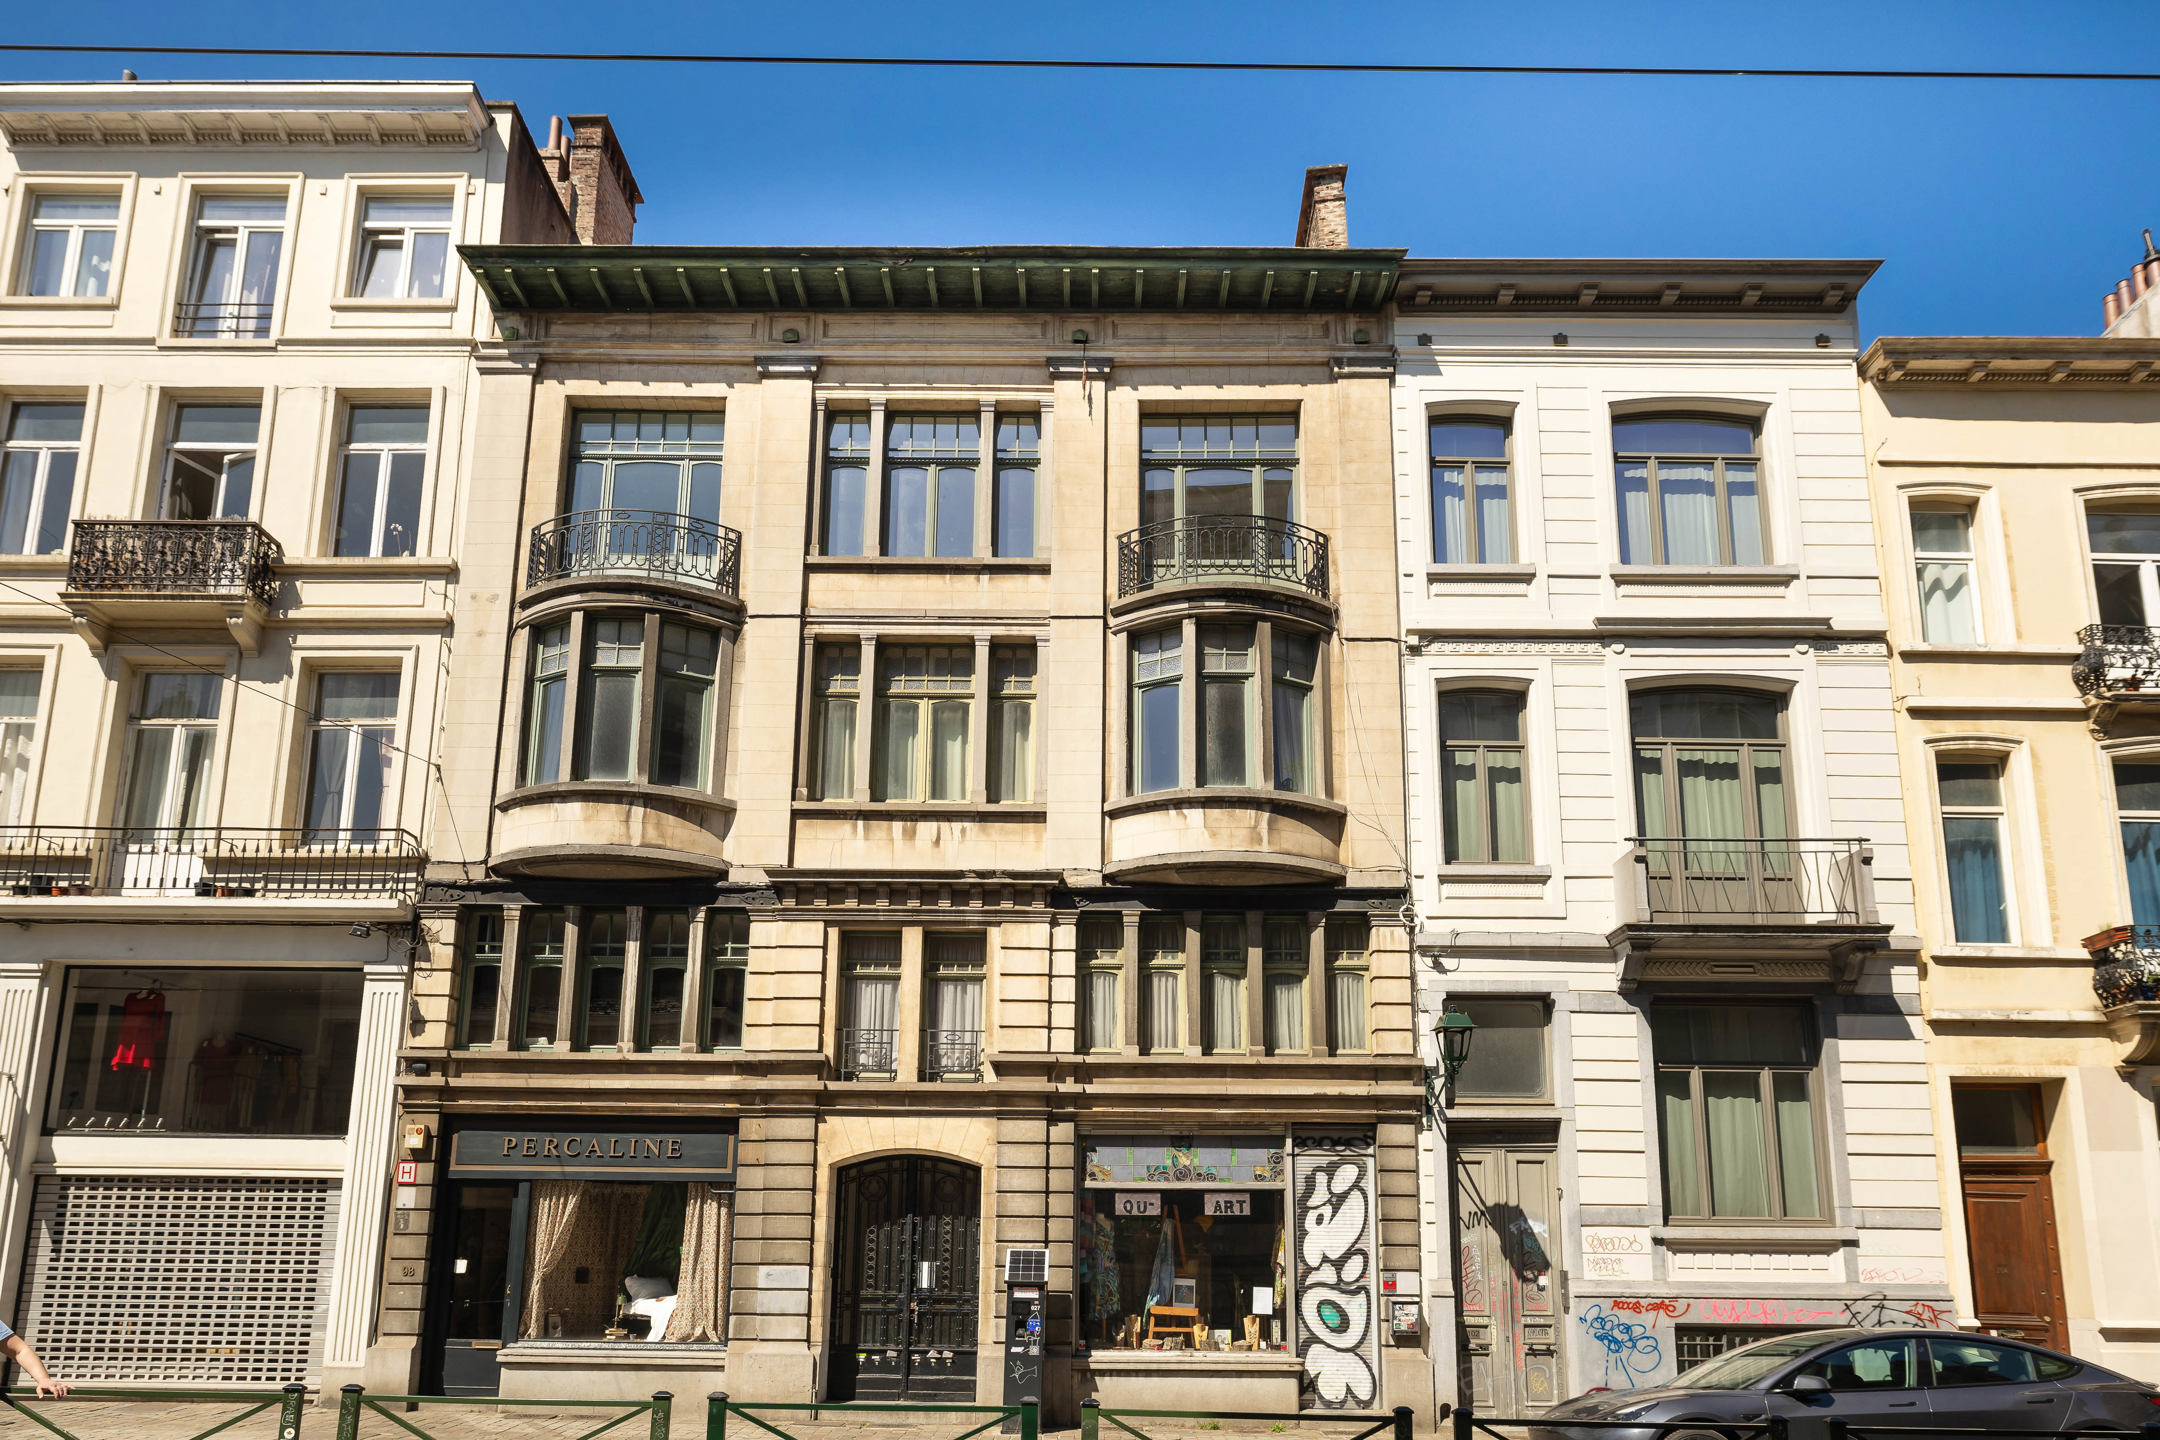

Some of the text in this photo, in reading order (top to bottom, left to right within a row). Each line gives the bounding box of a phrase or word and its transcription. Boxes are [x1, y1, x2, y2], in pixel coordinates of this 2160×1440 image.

[502, 1137, 683, 1158] PERCALINE
[401, 1165, 412, 1180] H
[1213, 1199, 1247, 1214] ART
[401, 1266, 415, 1277] 98
